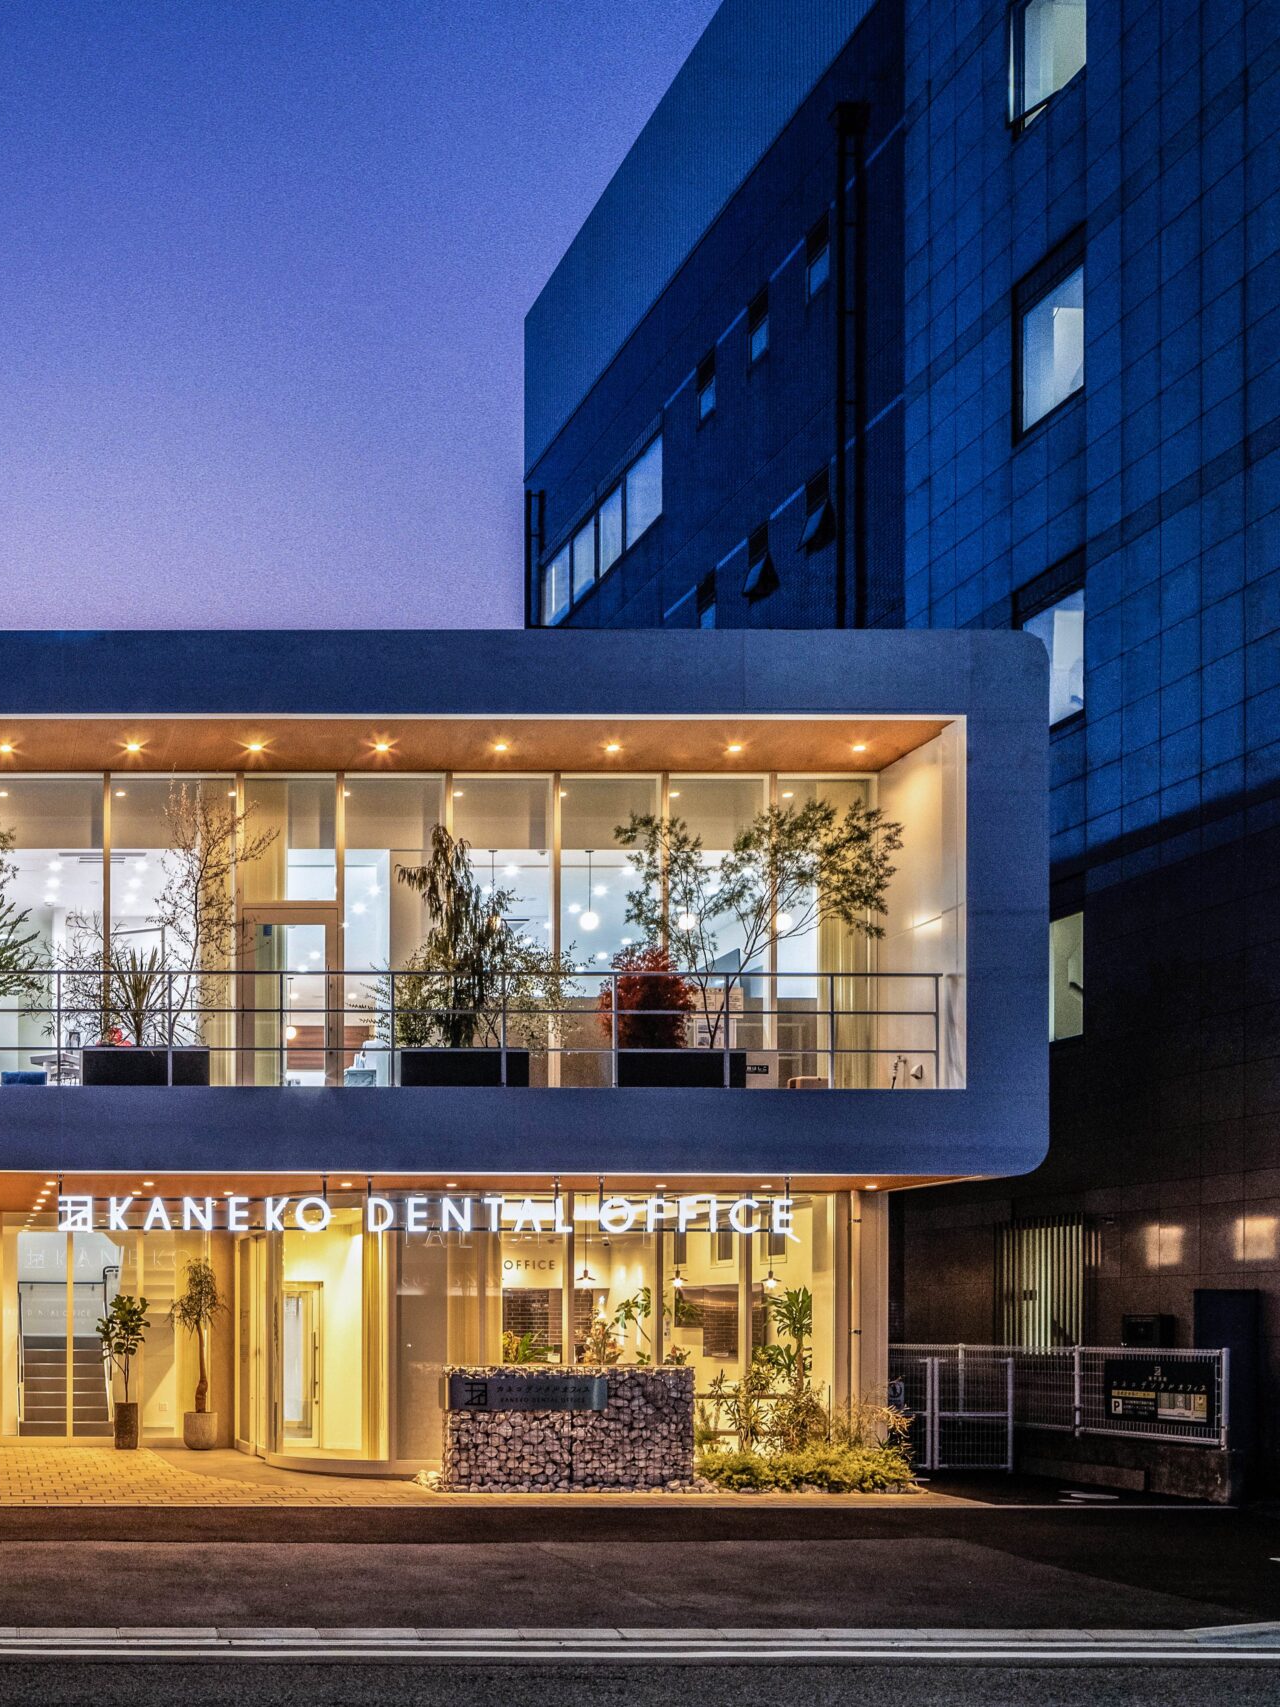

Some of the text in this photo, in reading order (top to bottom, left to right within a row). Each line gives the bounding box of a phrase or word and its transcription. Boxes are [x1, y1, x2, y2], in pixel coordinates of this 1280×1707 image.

[110, 1196, 794, 1234] KANEKO DENTAL OFFICE
[503, 1259, 556, 1270] OFFICE
[1113, 1400, 1120, 1411] P
